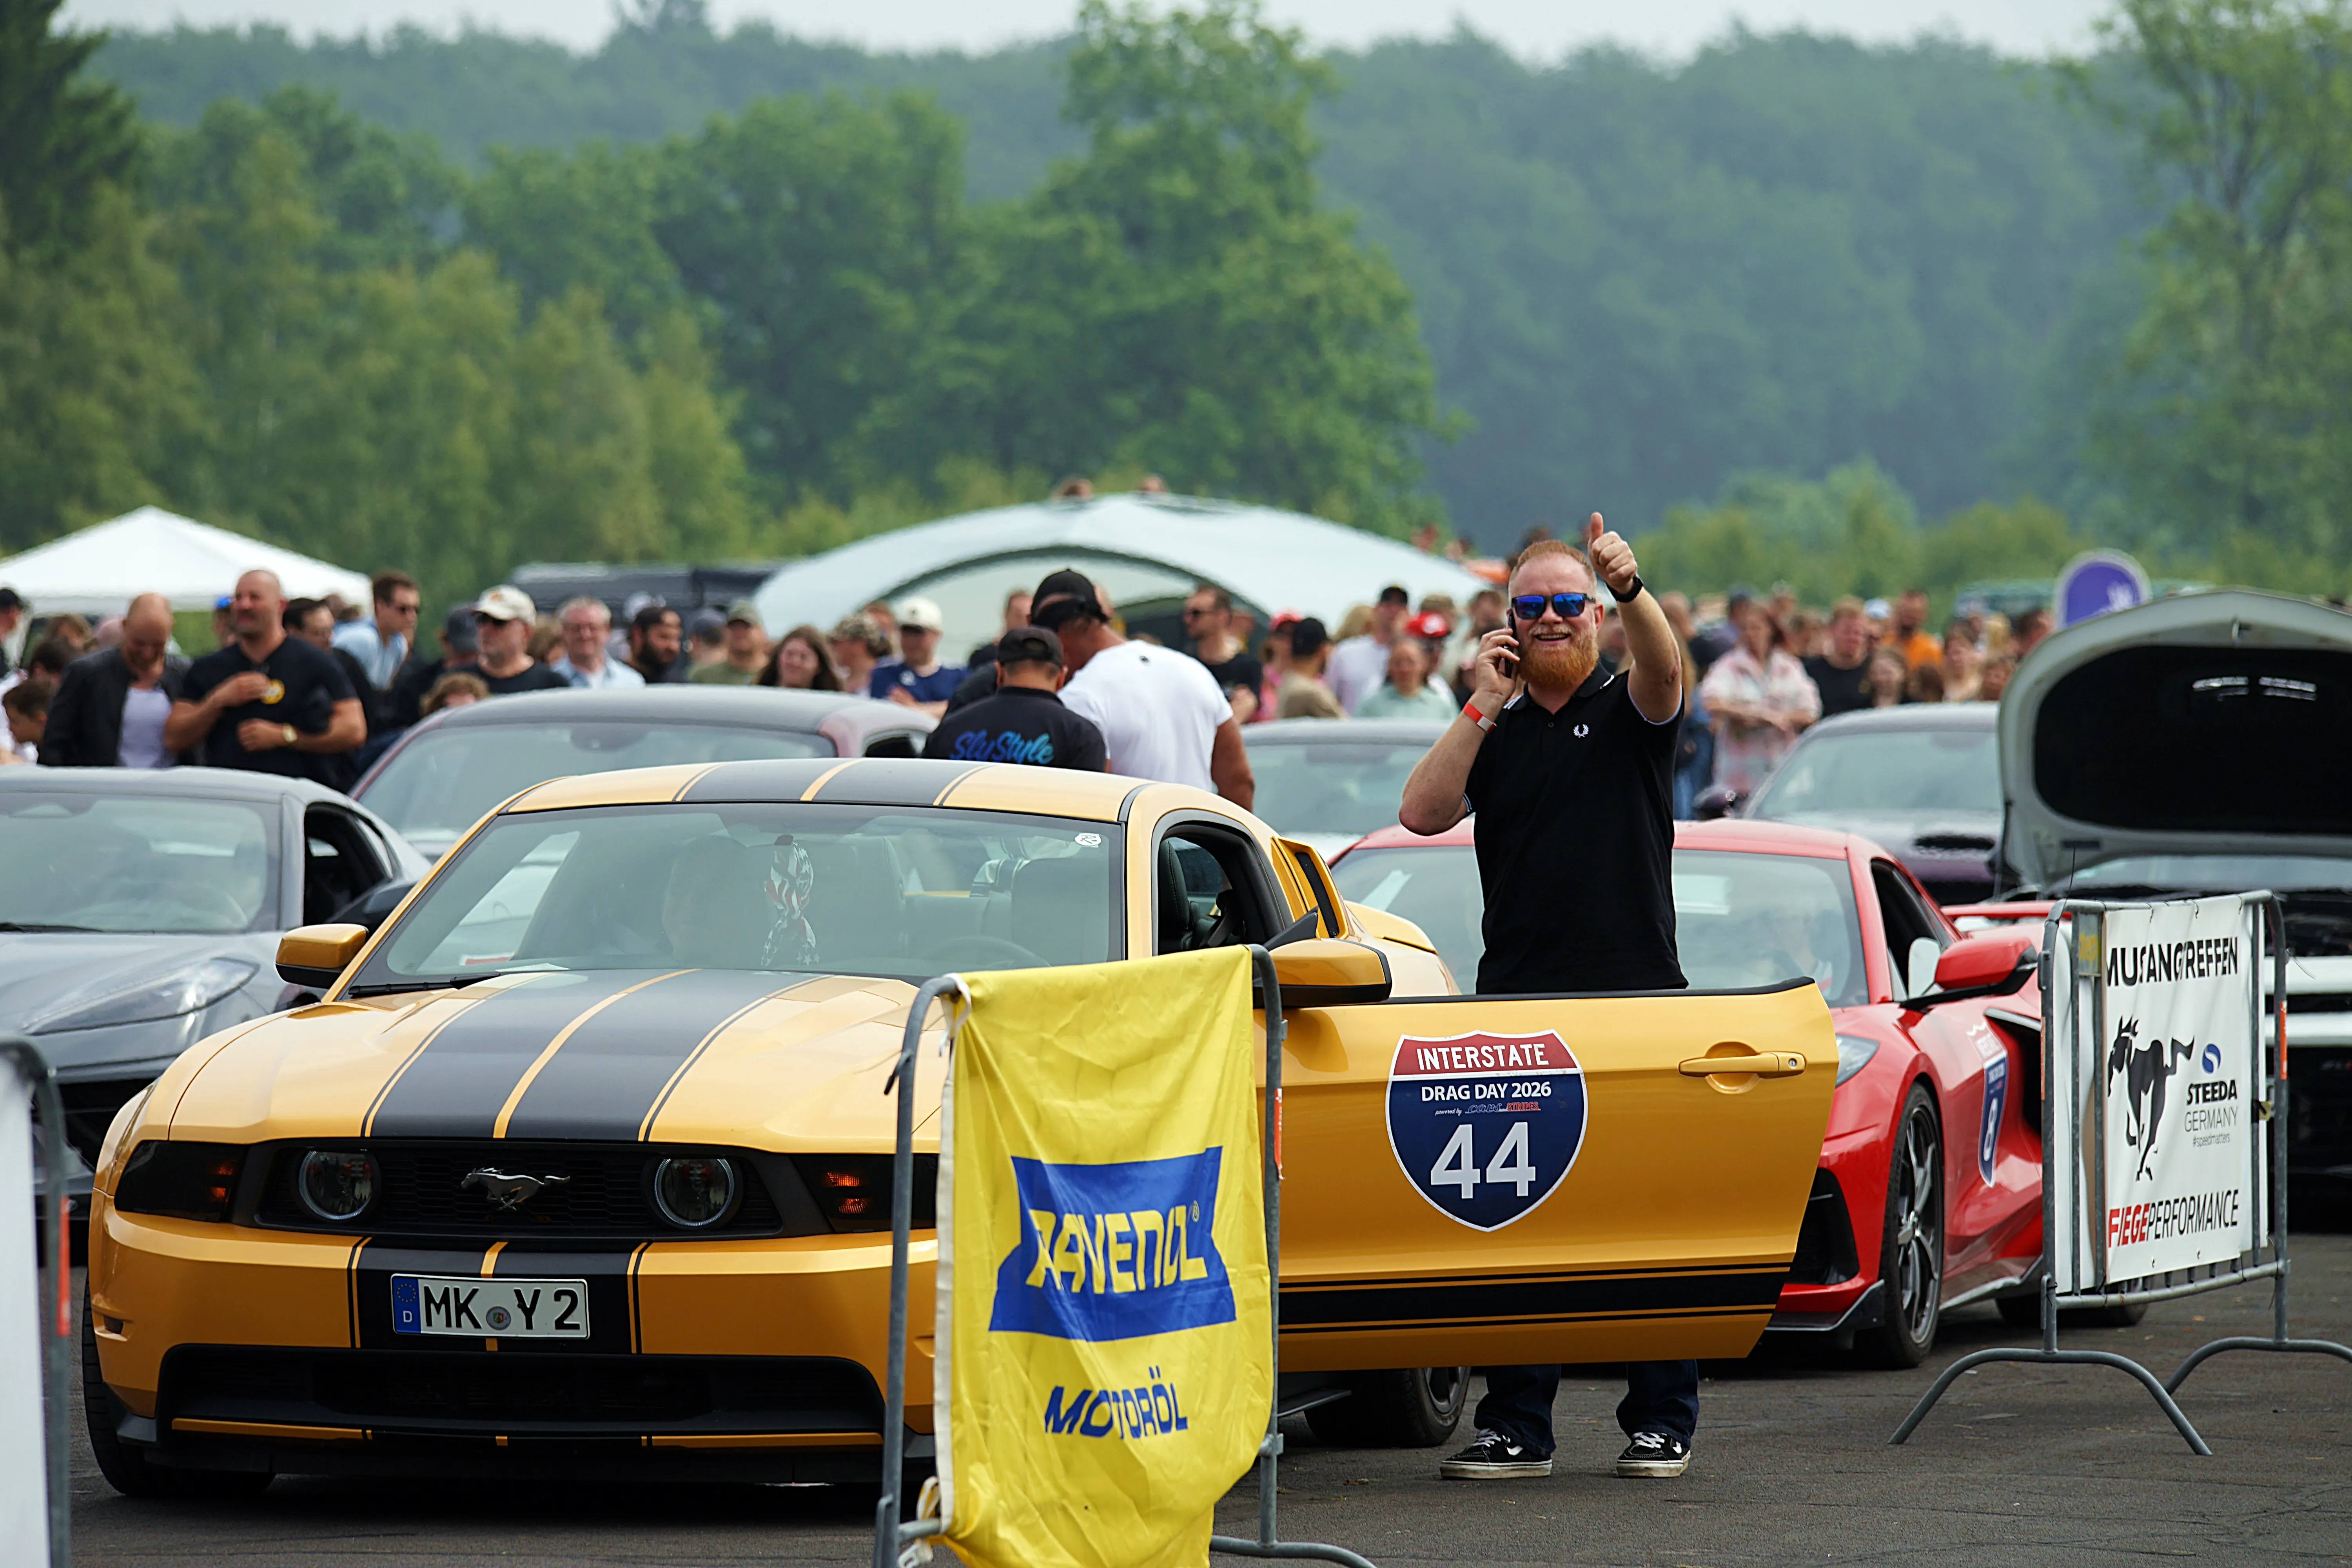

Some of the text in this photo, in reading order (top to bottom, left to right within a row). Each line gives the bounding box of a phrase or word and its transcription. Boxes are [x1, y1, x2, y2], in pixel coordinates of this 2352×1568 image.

[1416, 1044, 1549, 1071] INTERSTATE
[1421, 1081, 1552, 1102] DRAG DAY 2026
[2186, 1080, 2238, 1105] STEEDA
[1435, 1108, 1455, 1116] powered
[1456, 1108, 1462, 1116] by
[1506, 1102, 1539, 1111] STRIPES
[2184, 1106, 2238, 1132] GERMANY
[1984, 1097, 1998, 1161] 8
[1430, 1122, 1536, 1199] 44
[2108, 1189, 2239, 1248] FIEGEPERFORMANCE
[403, 1310, 412, 1323] D
[423, 1286, 482, 1329] MK
[513, 1288, 541, 1330] Y
[554, 1289, 580, 1330] 2
[1044, 1366, 1188, 1439] MOTORÖL
